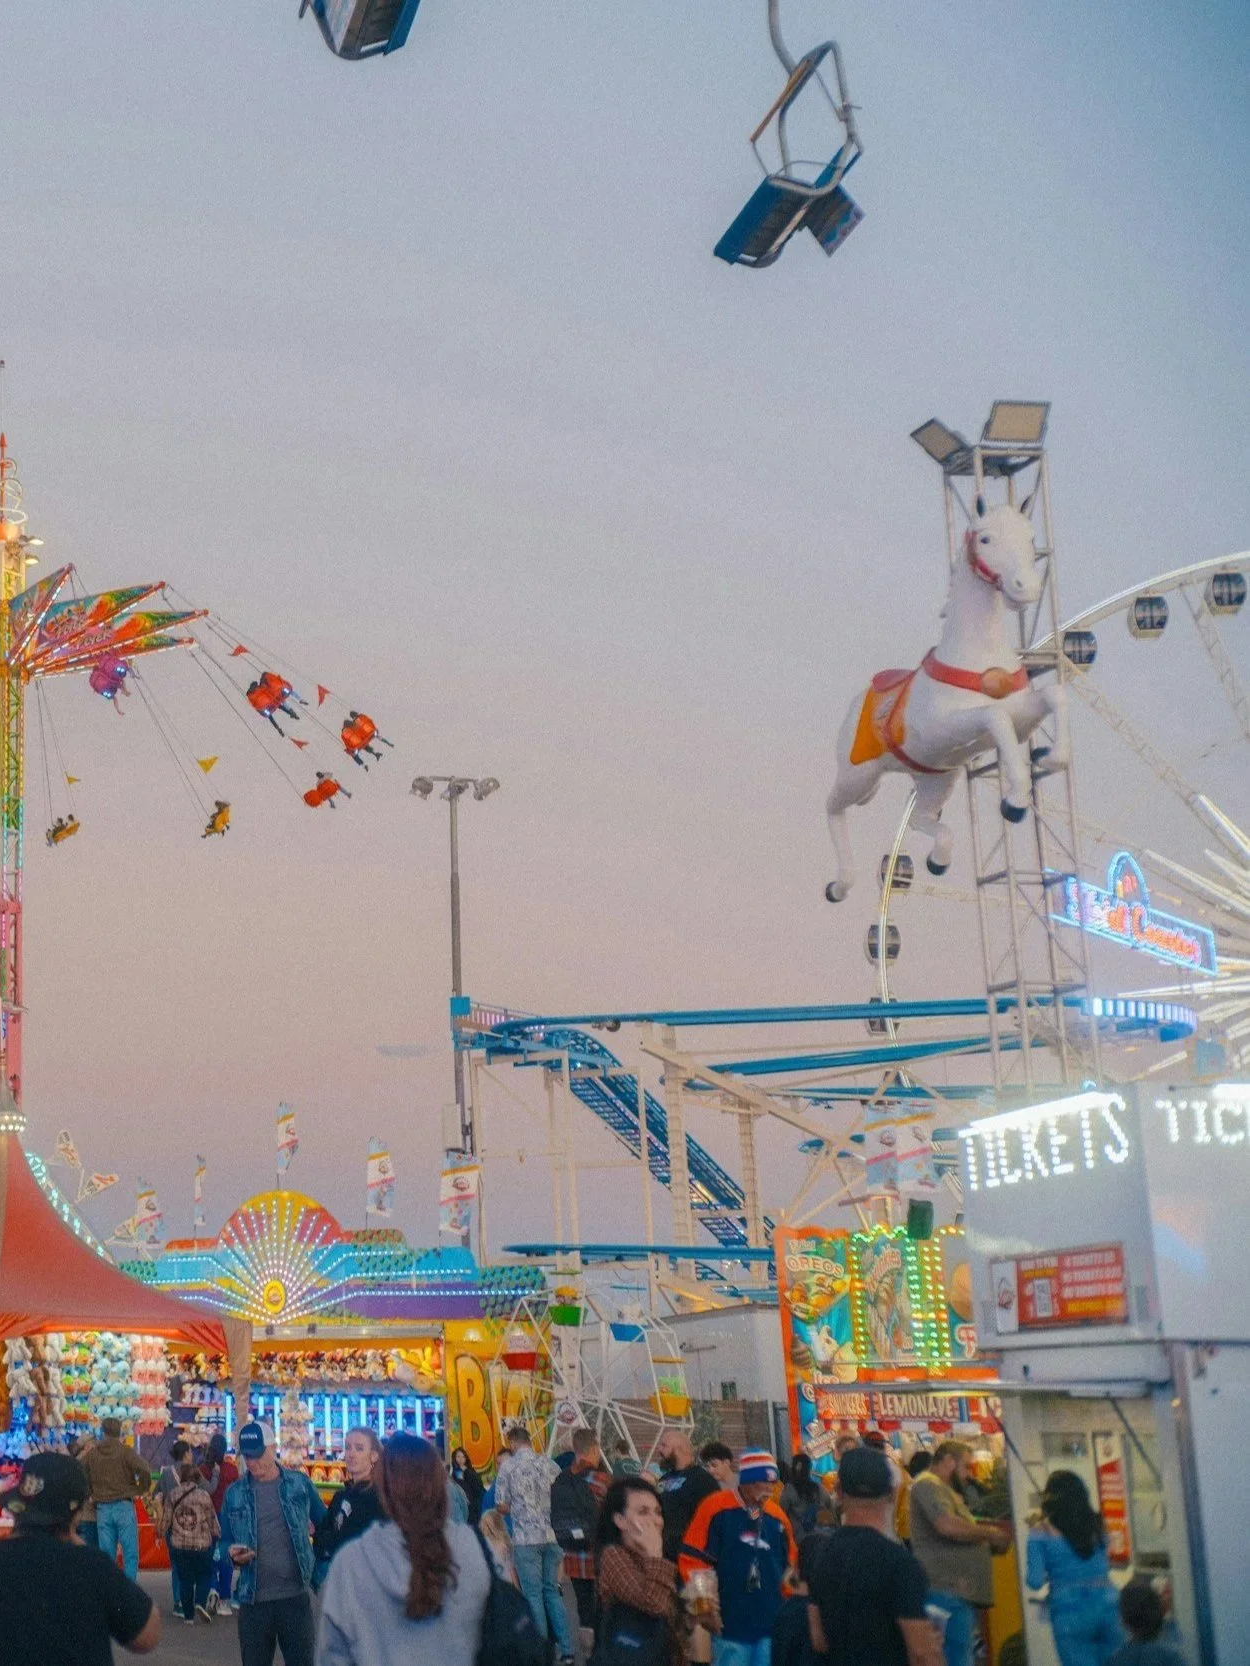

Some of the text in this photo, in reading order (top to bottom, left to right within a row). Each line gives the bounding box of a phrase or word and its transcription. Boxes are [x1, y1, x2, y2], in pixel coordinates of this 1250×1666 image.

[958, 1092, 1129, 1190] TICKETS
[1154, 1099, 1250, 1144] TIC
[878, 1392, 957, 1418] LEMONADE
